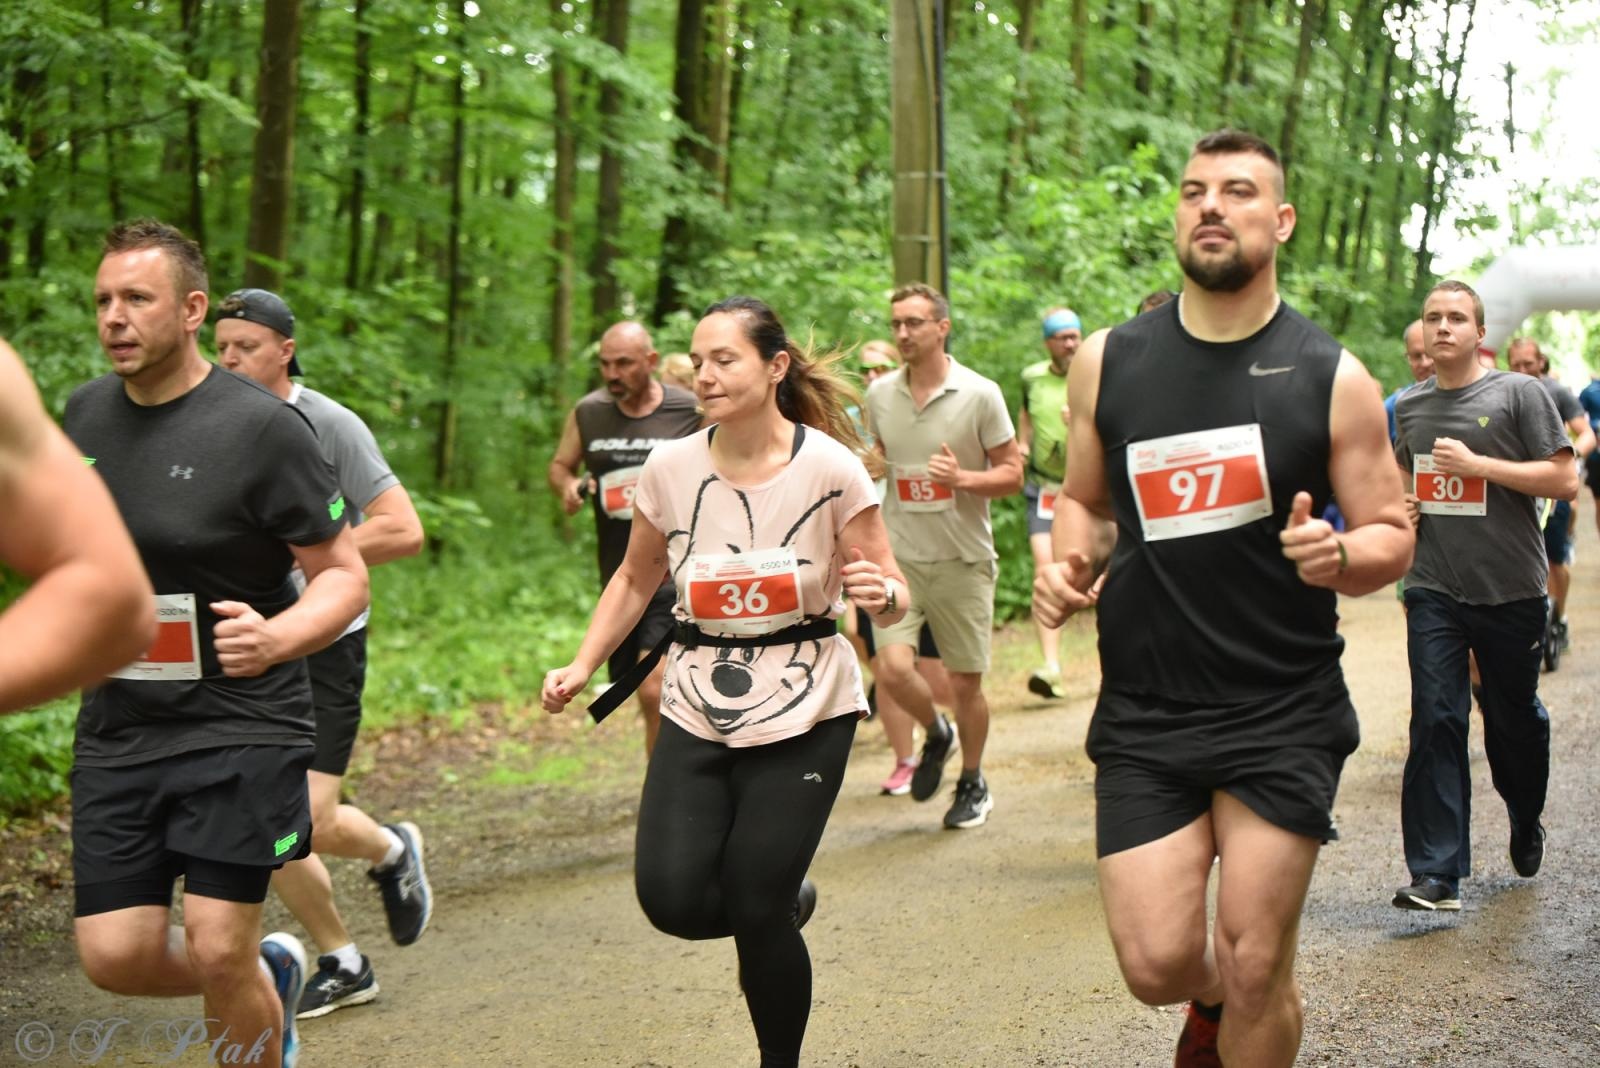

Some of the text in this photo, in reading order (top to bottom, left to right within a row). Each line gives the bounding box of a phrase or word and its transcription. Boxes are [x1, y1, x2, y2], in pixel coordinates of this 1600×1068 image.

[909, 480, 935, 501] 85
[1168, 463, 1225, 513] 97
[1432, 475, 1464, 501] 30
[718, 580, 769, 616] 36
